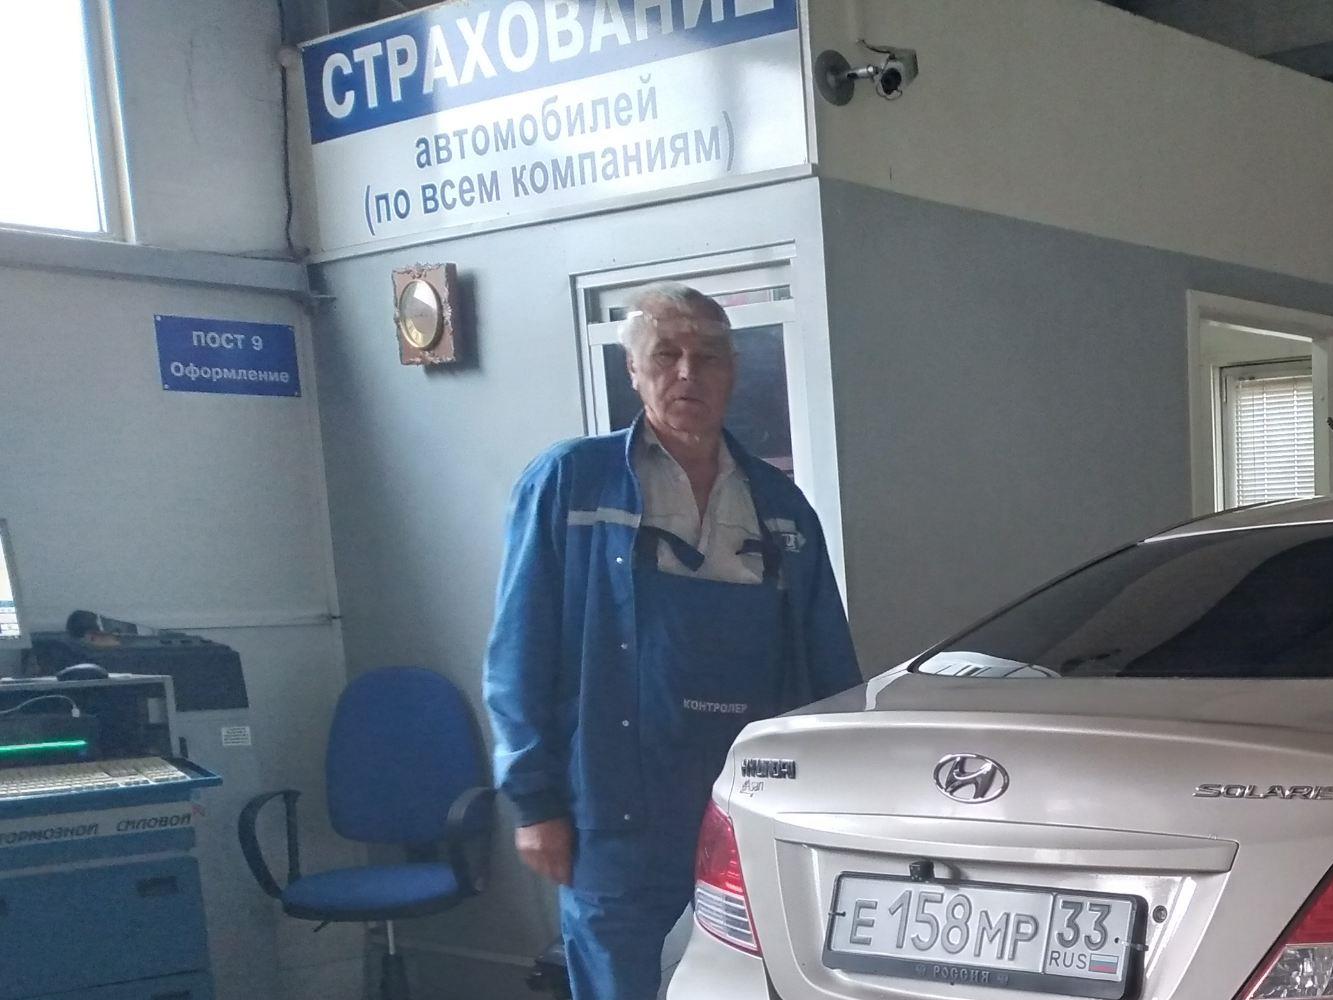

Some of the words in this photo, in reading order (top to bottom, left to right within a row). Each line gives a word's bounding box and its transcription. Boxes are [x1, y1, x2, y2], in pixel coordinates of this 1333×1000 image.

[321, 0, 775, 119] СТРАХОВАН
[415, 73, 659, 169] автомобилей
[364, 185, 411, 236] (по
[423, 172, 500, 214] всем
[513, 110, 735, 199] компаниям)
[192, 331, 246, 349] ПОСТ
[252, 336, 264, 351] 9
[170, 361, 289, 383] Оформление
[683, 698, 748, 713] КОНТРОЛЕР
[1056, 900, 1113, 951] 33
[1049, 950, 1088, 970] RUS
[933, 965, 990, 983] РОССИЯ
